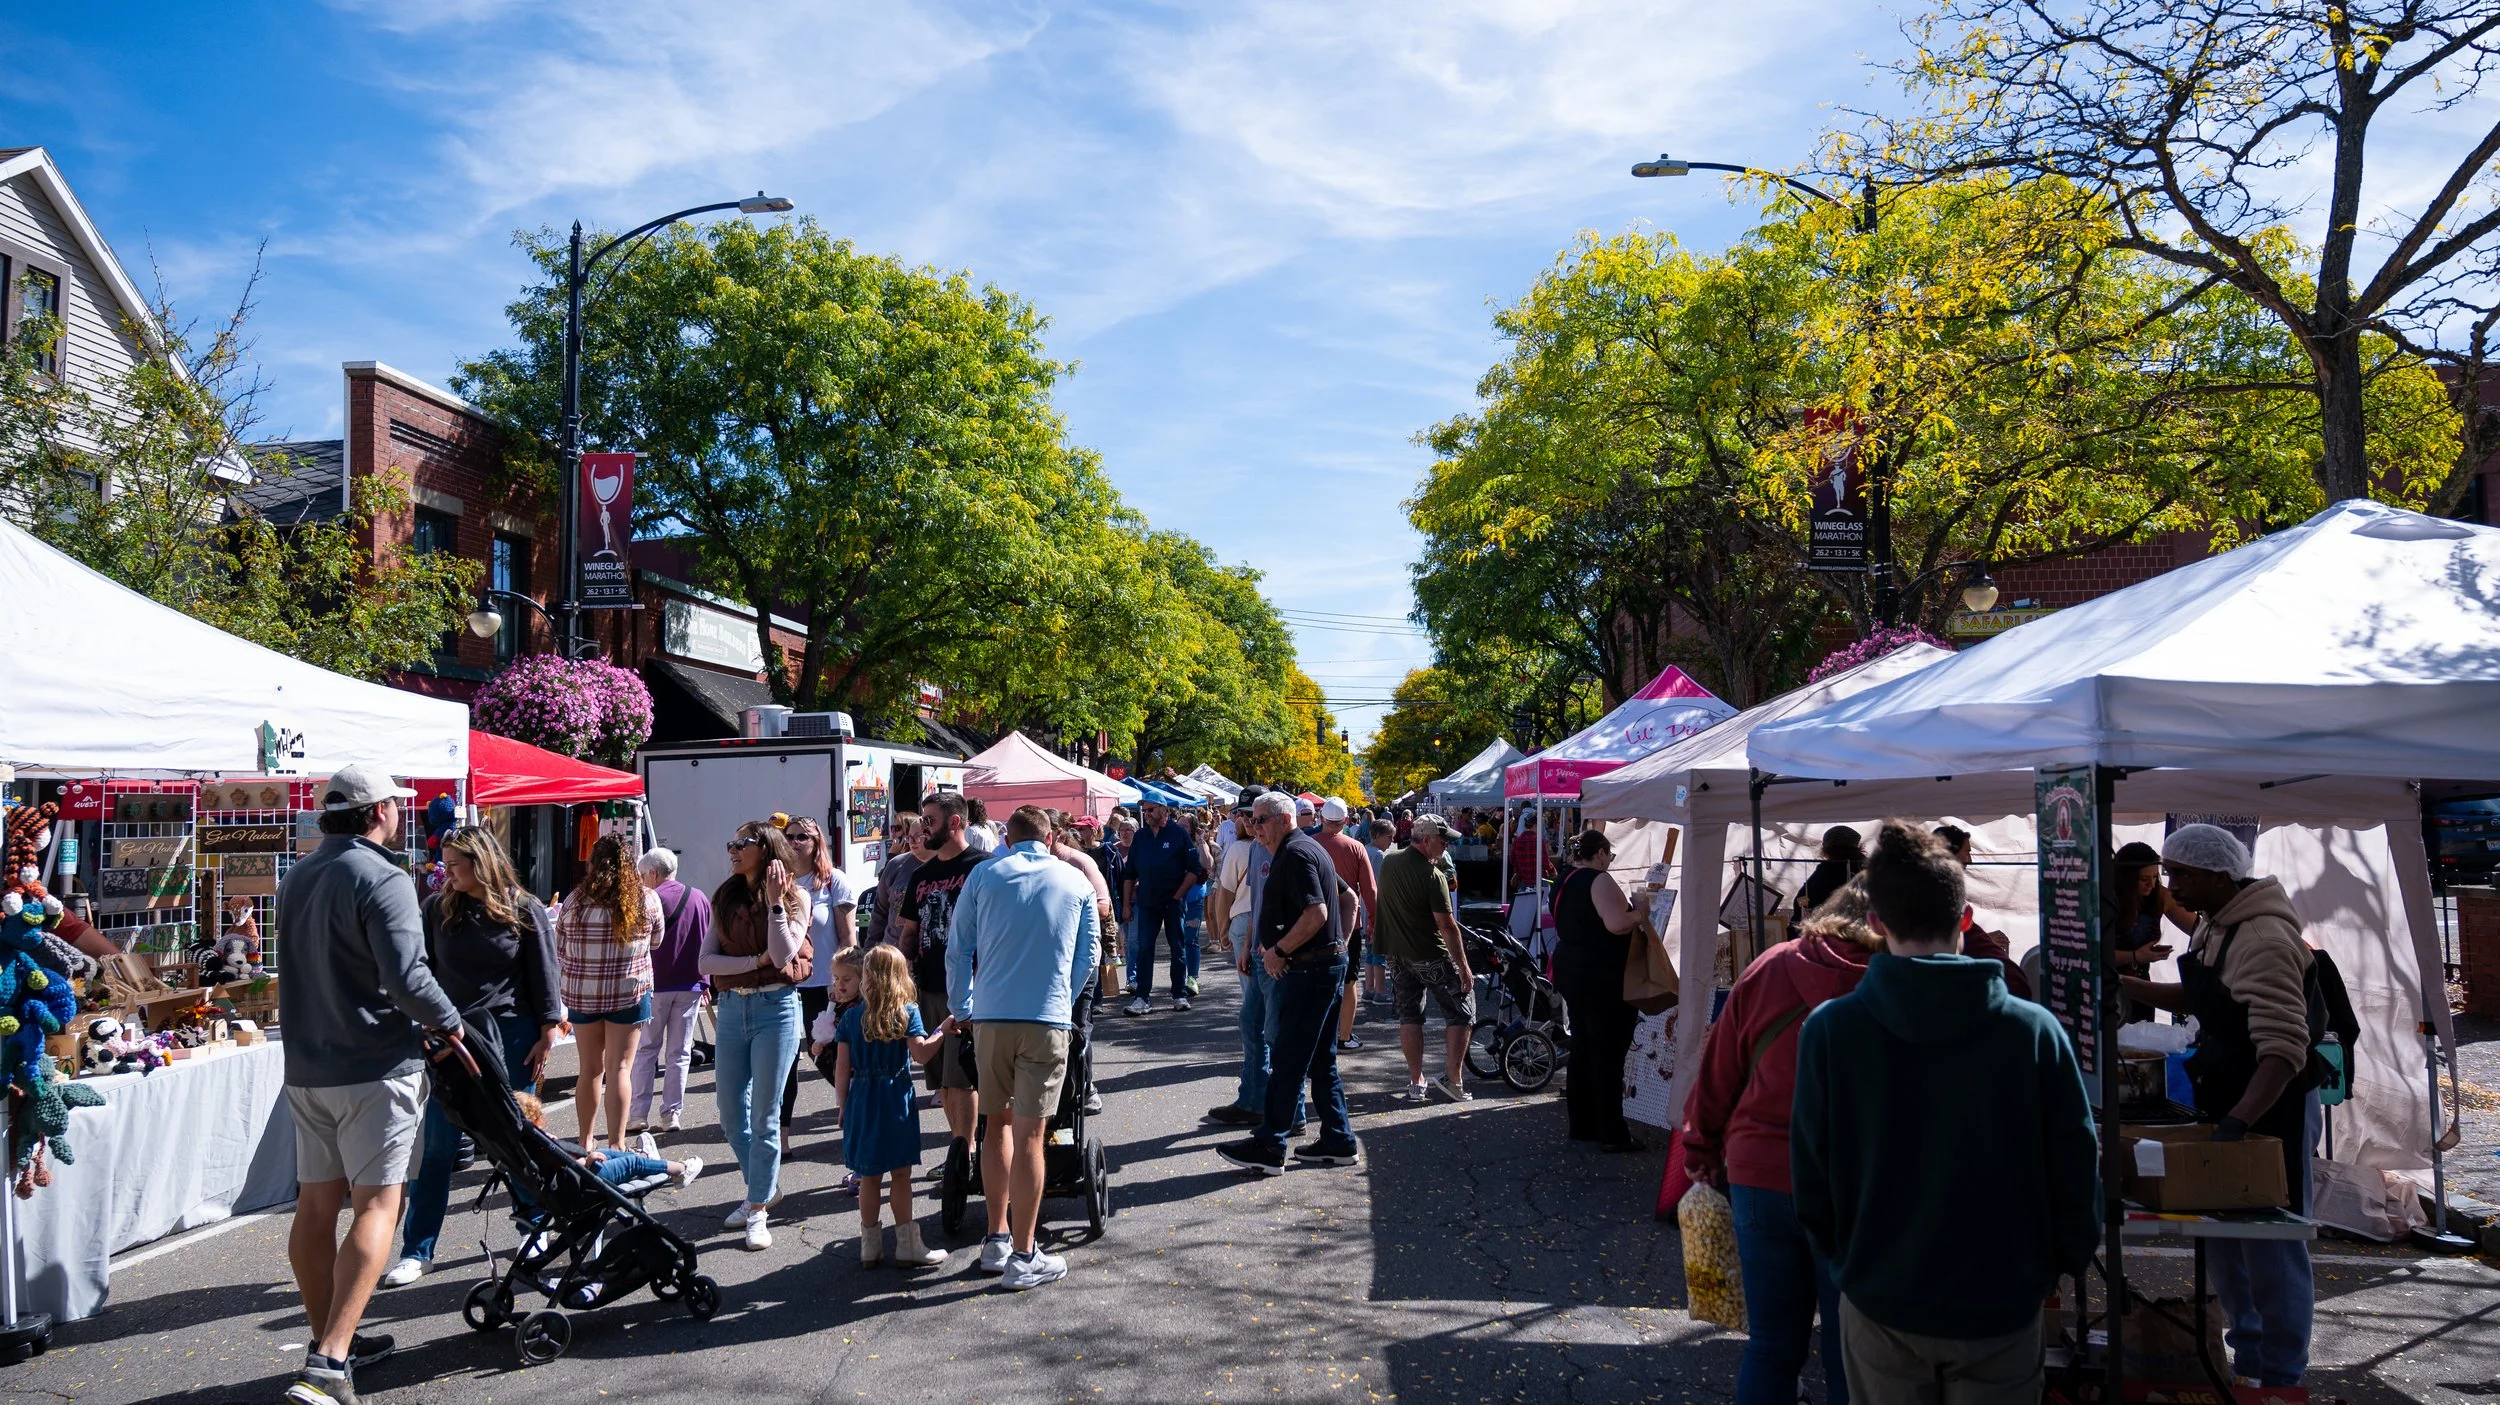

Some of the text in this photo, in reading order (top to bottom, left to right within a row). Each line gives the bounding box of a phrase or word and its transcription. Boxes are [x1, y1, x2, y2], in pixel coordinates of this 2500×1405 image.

[1814, 521, 1863, 531] WINEGLASS
[1814, 532, 1863, 540] MARATHON
[1961, 615, 2019, 629] SAFARI
[74, 800, 101, 808] QUEST
[205, 829, 283, 845] Get Naked
[119, 842, 142, 858] Get
